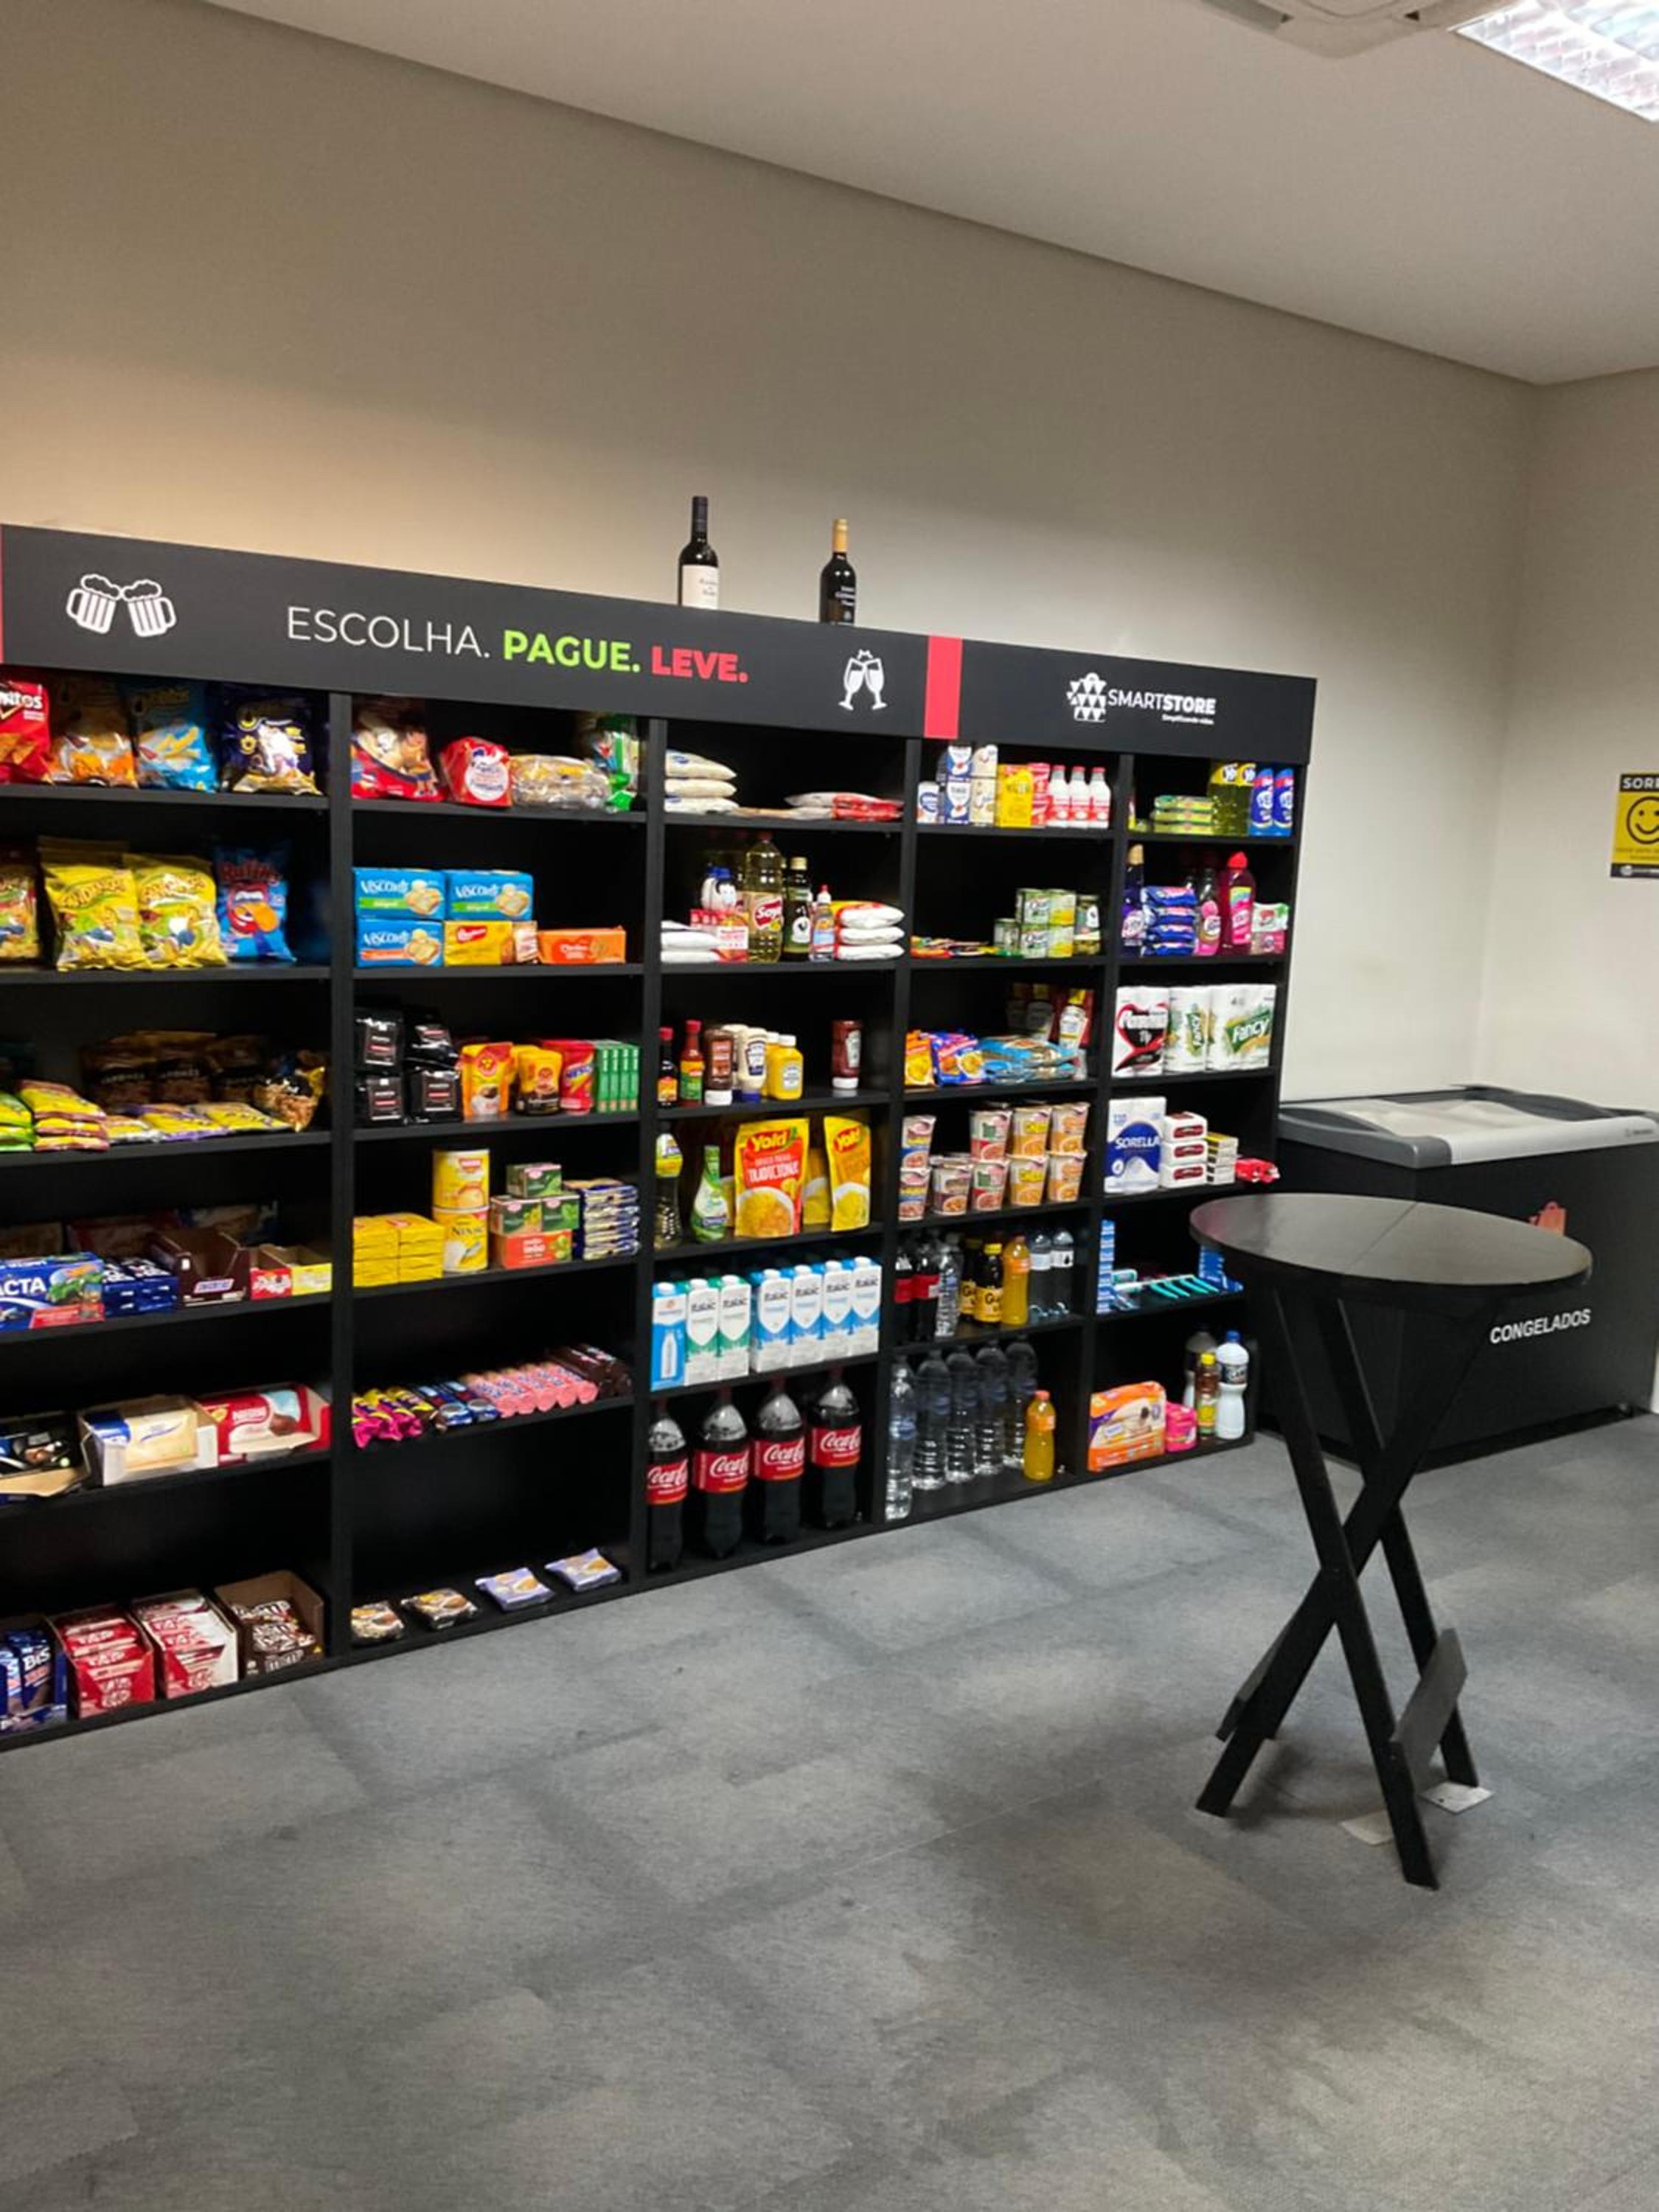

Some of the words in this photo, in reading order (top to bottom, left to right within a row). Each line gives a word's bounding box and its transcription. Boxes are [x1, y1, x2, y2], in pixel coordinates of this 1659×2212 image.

[287, 605, 490, 659] ESCOLHA.
[503, 629, 641, 674] PAGUE.
[651, 645, 748, 684] LEVE.
[1107, 688, 1216, 715] SMARTSTORE
[0, 1276, 44, 1296] CTA
[1489, 1308, 1592, 1344] CONGELADOS
